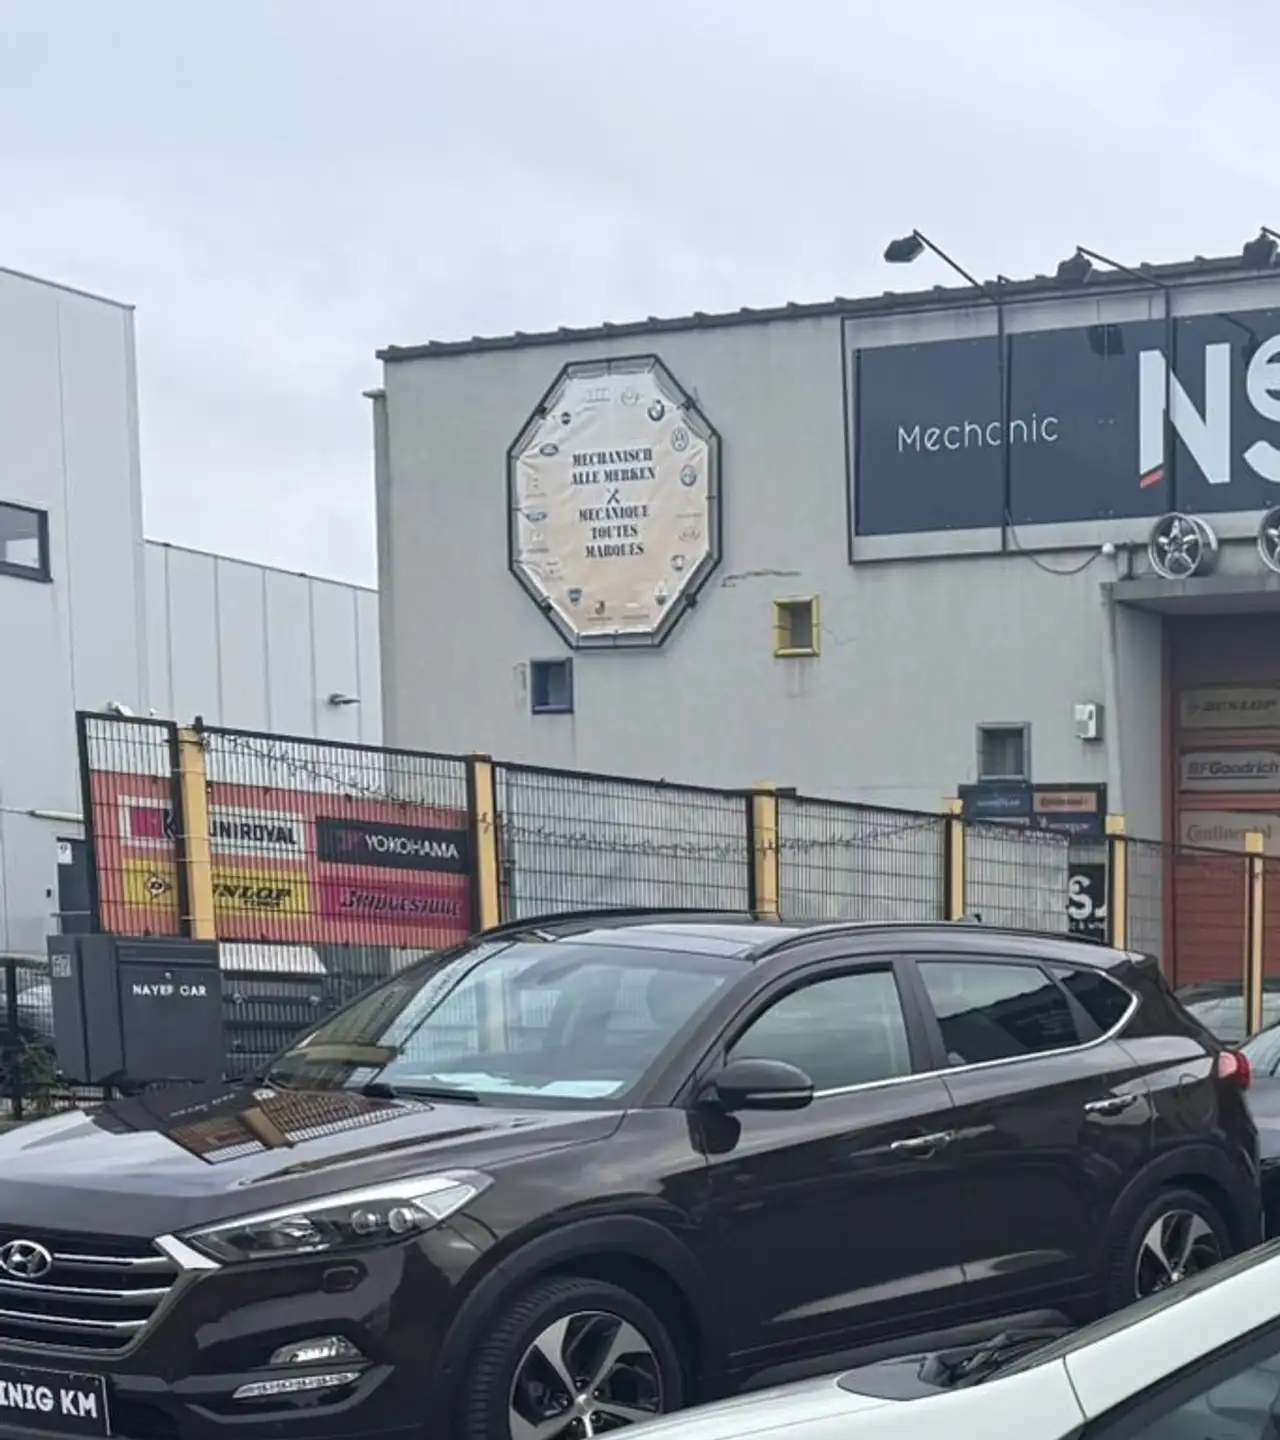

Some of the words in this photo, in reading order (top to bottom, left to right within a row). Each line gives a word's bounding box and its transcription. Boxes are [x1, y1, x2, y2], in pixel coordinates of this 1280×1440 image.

[572, 448, 653, 467] MECHANISCH
[570, 470, 601, 485] ALLE
[603, 466, 656, 483] MERKEN
[590, 524, 639, 540] TOUTES
[585, 542, 645, 559] MARQUES
[1187, 760, 1280, 776] BFGoodrich
[364, 833, 461, 860] YOKOHAMA
[180, 984, 208, 998] CAR
[60, 1388, 97, 1418] KM
